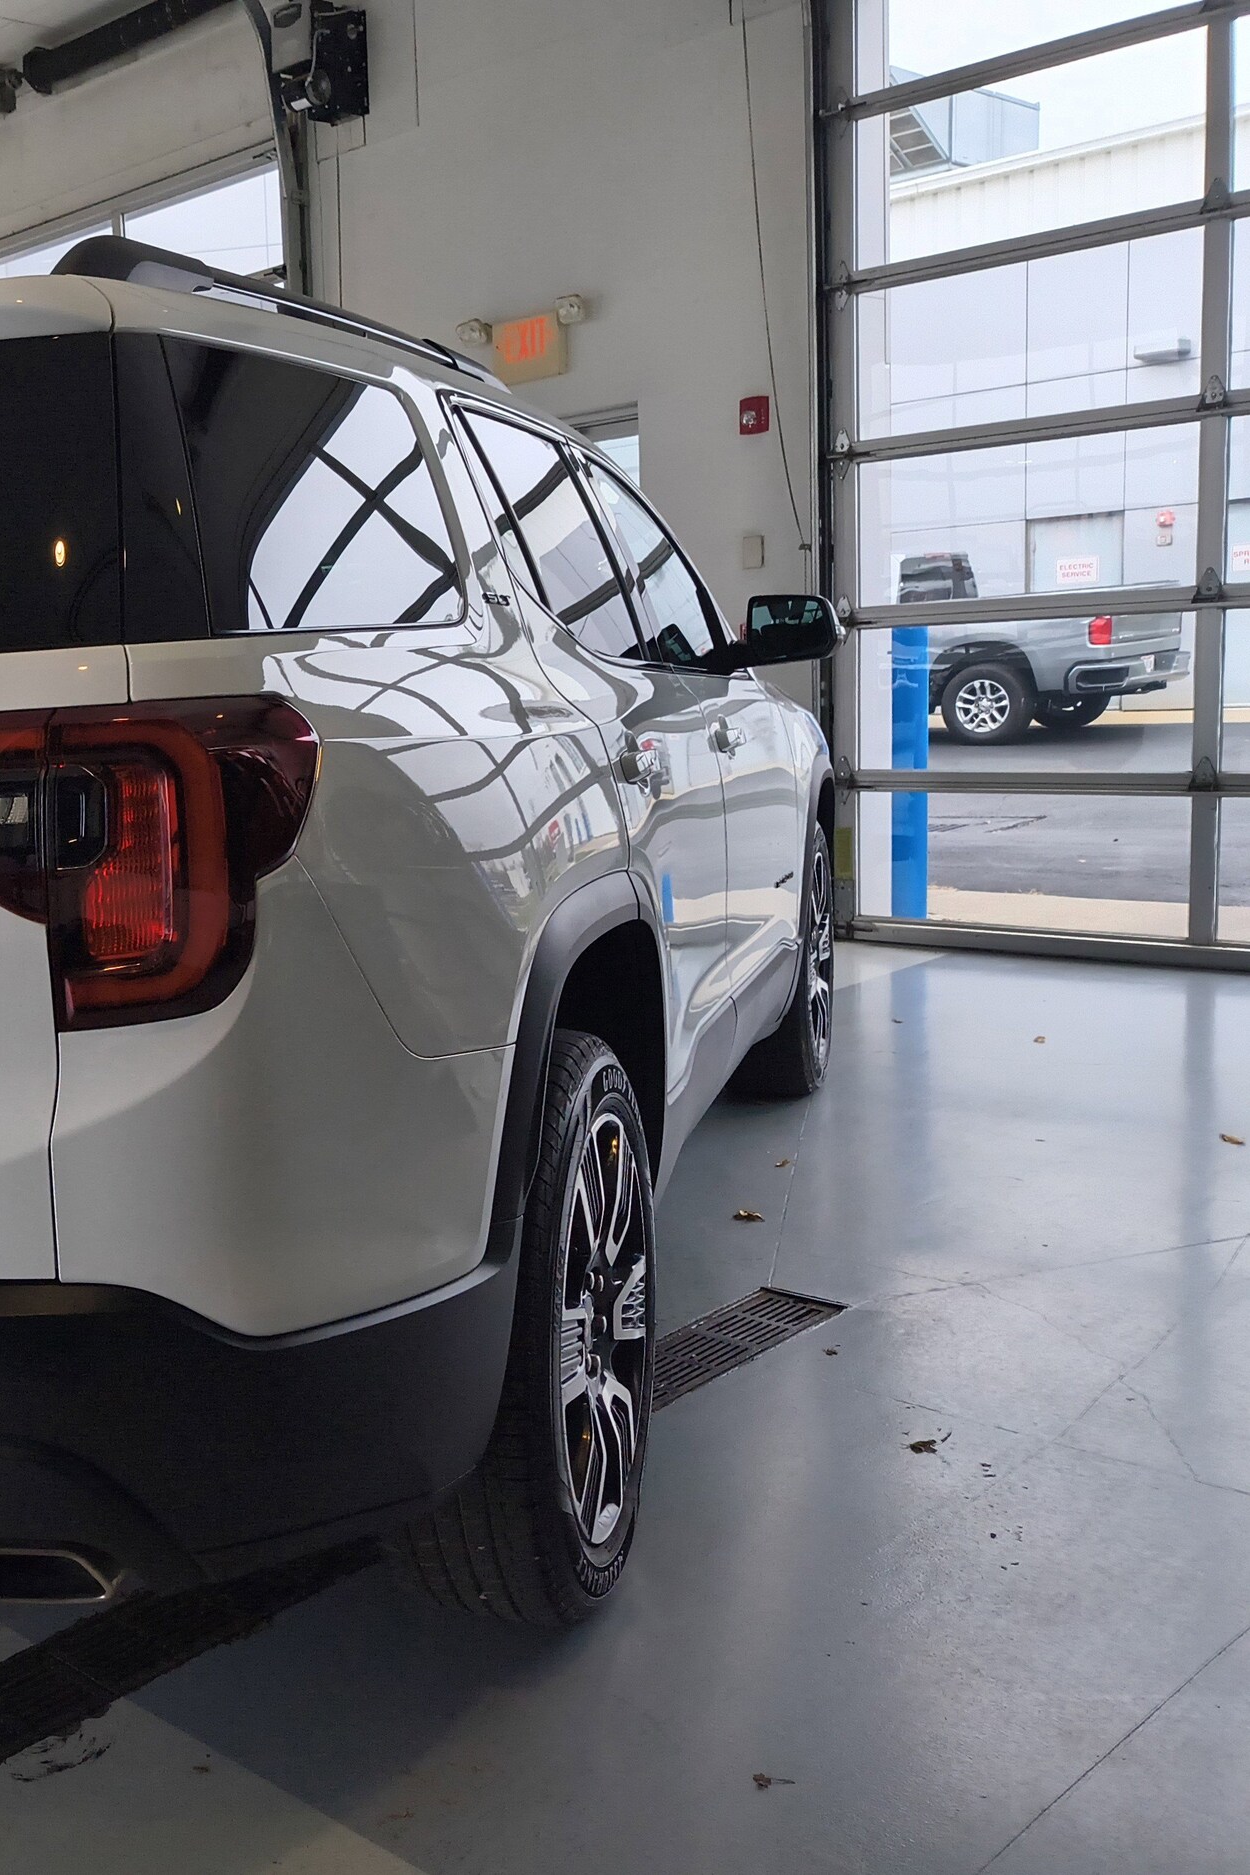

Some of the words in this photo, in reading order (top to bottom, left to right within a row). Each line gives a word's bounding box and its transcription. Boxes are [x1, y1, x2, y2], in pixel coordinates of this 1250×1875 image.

[505, 317, 548, 363] EXIT
[1059, 562, 1094, 571] ELECTRIC
[1061, 571, 1092, 579] SERVICE
